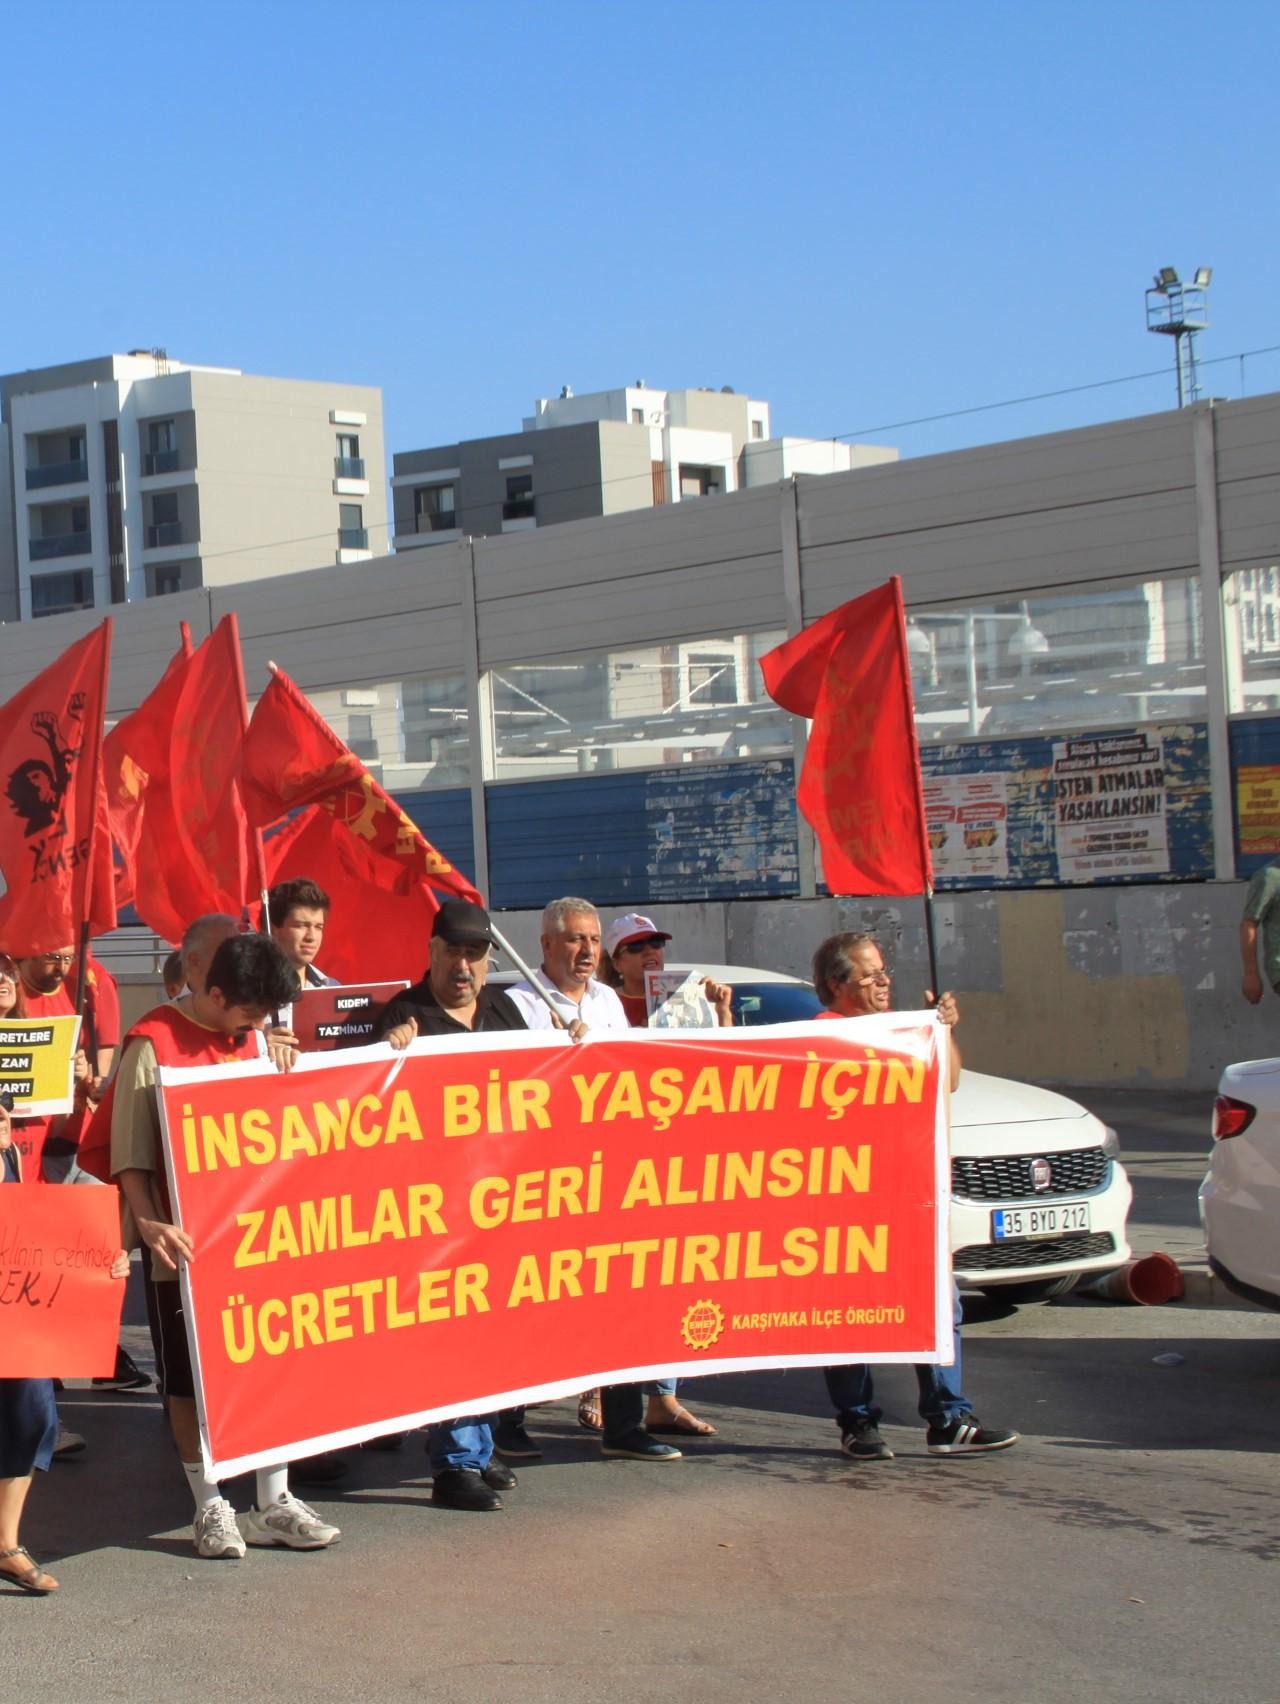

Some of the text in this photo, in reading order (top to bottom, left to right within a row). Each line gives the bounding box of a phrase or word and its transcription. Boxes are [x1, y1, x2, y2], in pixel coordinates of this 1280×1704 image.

[1098, 768, 1164, 794] ATMALAR
[1058, 794, 1161, 822] YASAKLANSIN!
[337, 997, 369, 1009] KIDEM
[0, 1057, 30, 1068] ZAM
[181, 1048, 926, 1174] İNSANCA BİR YAŞAM İÇİN
[233, 1144, 872, 1269] ZAMLAR GERİ ALINSIN
[1004, 1212, 1023, 1234] 35
[1062, 1207, 1087, 1229] 212
[221, 1224, 889, 1364] ÜCRETLER ARTTIRILSIN
[732, 1305, 905, 1332] KARŞIYAKA İLÇE ÖRGÜTÜ
